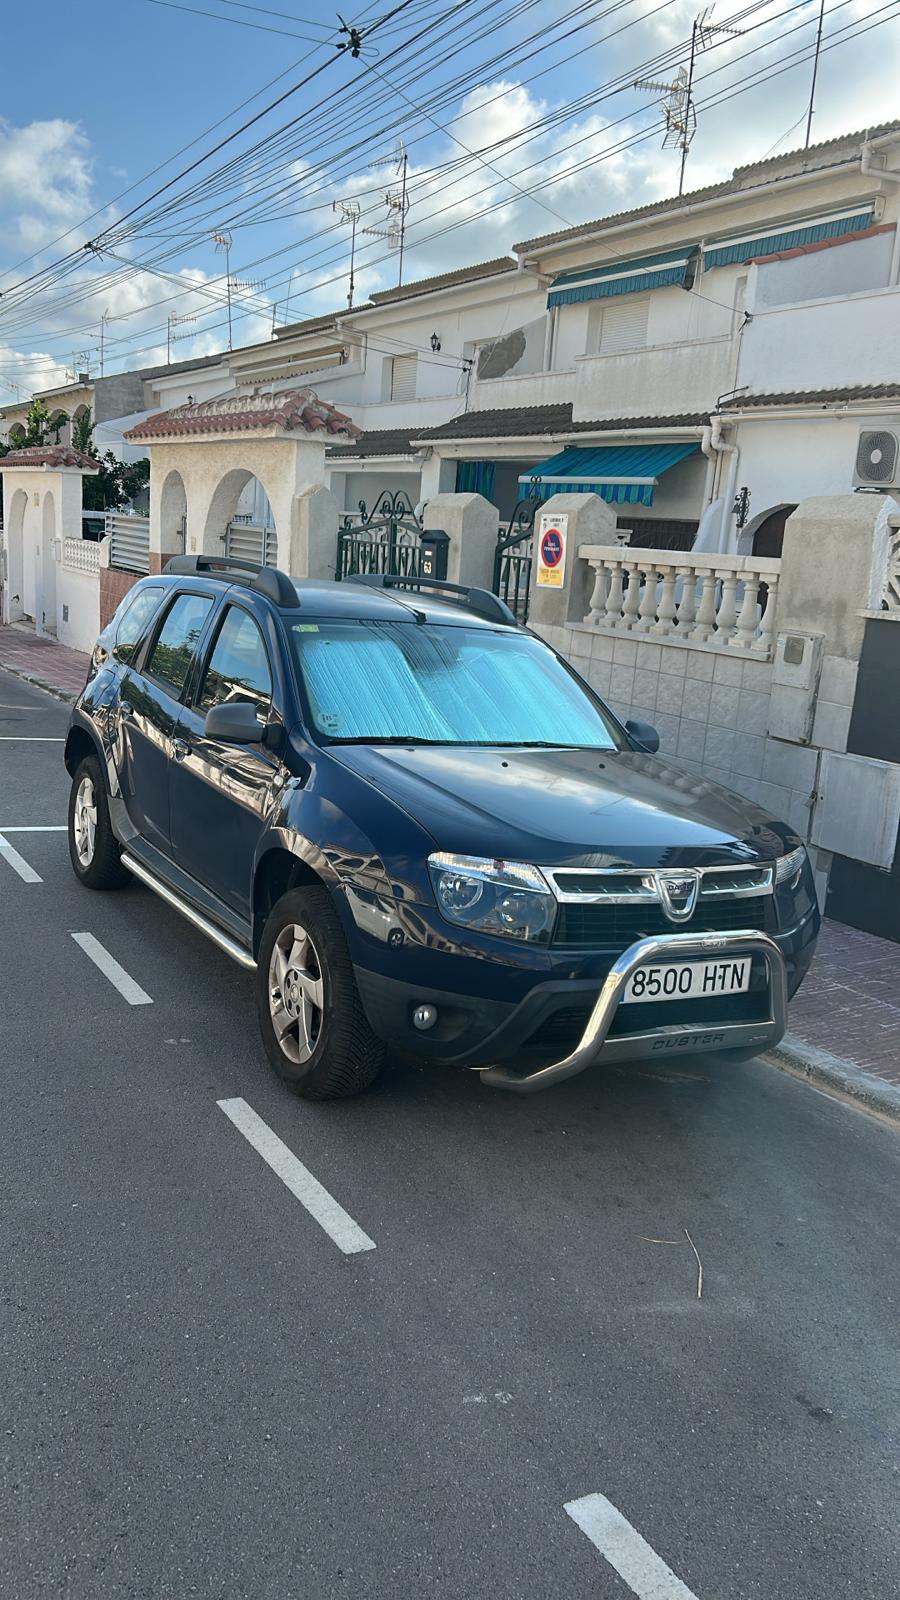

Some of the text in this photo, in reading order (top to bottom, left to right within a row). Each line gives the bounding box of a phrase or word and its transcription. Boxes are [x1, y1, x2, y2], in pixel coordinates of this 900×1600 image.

[423, 561, 432, 574] 63
[631, 963, 745, 997] 8500 HTN
[651, 1033, 725, 1050] DUSTER
